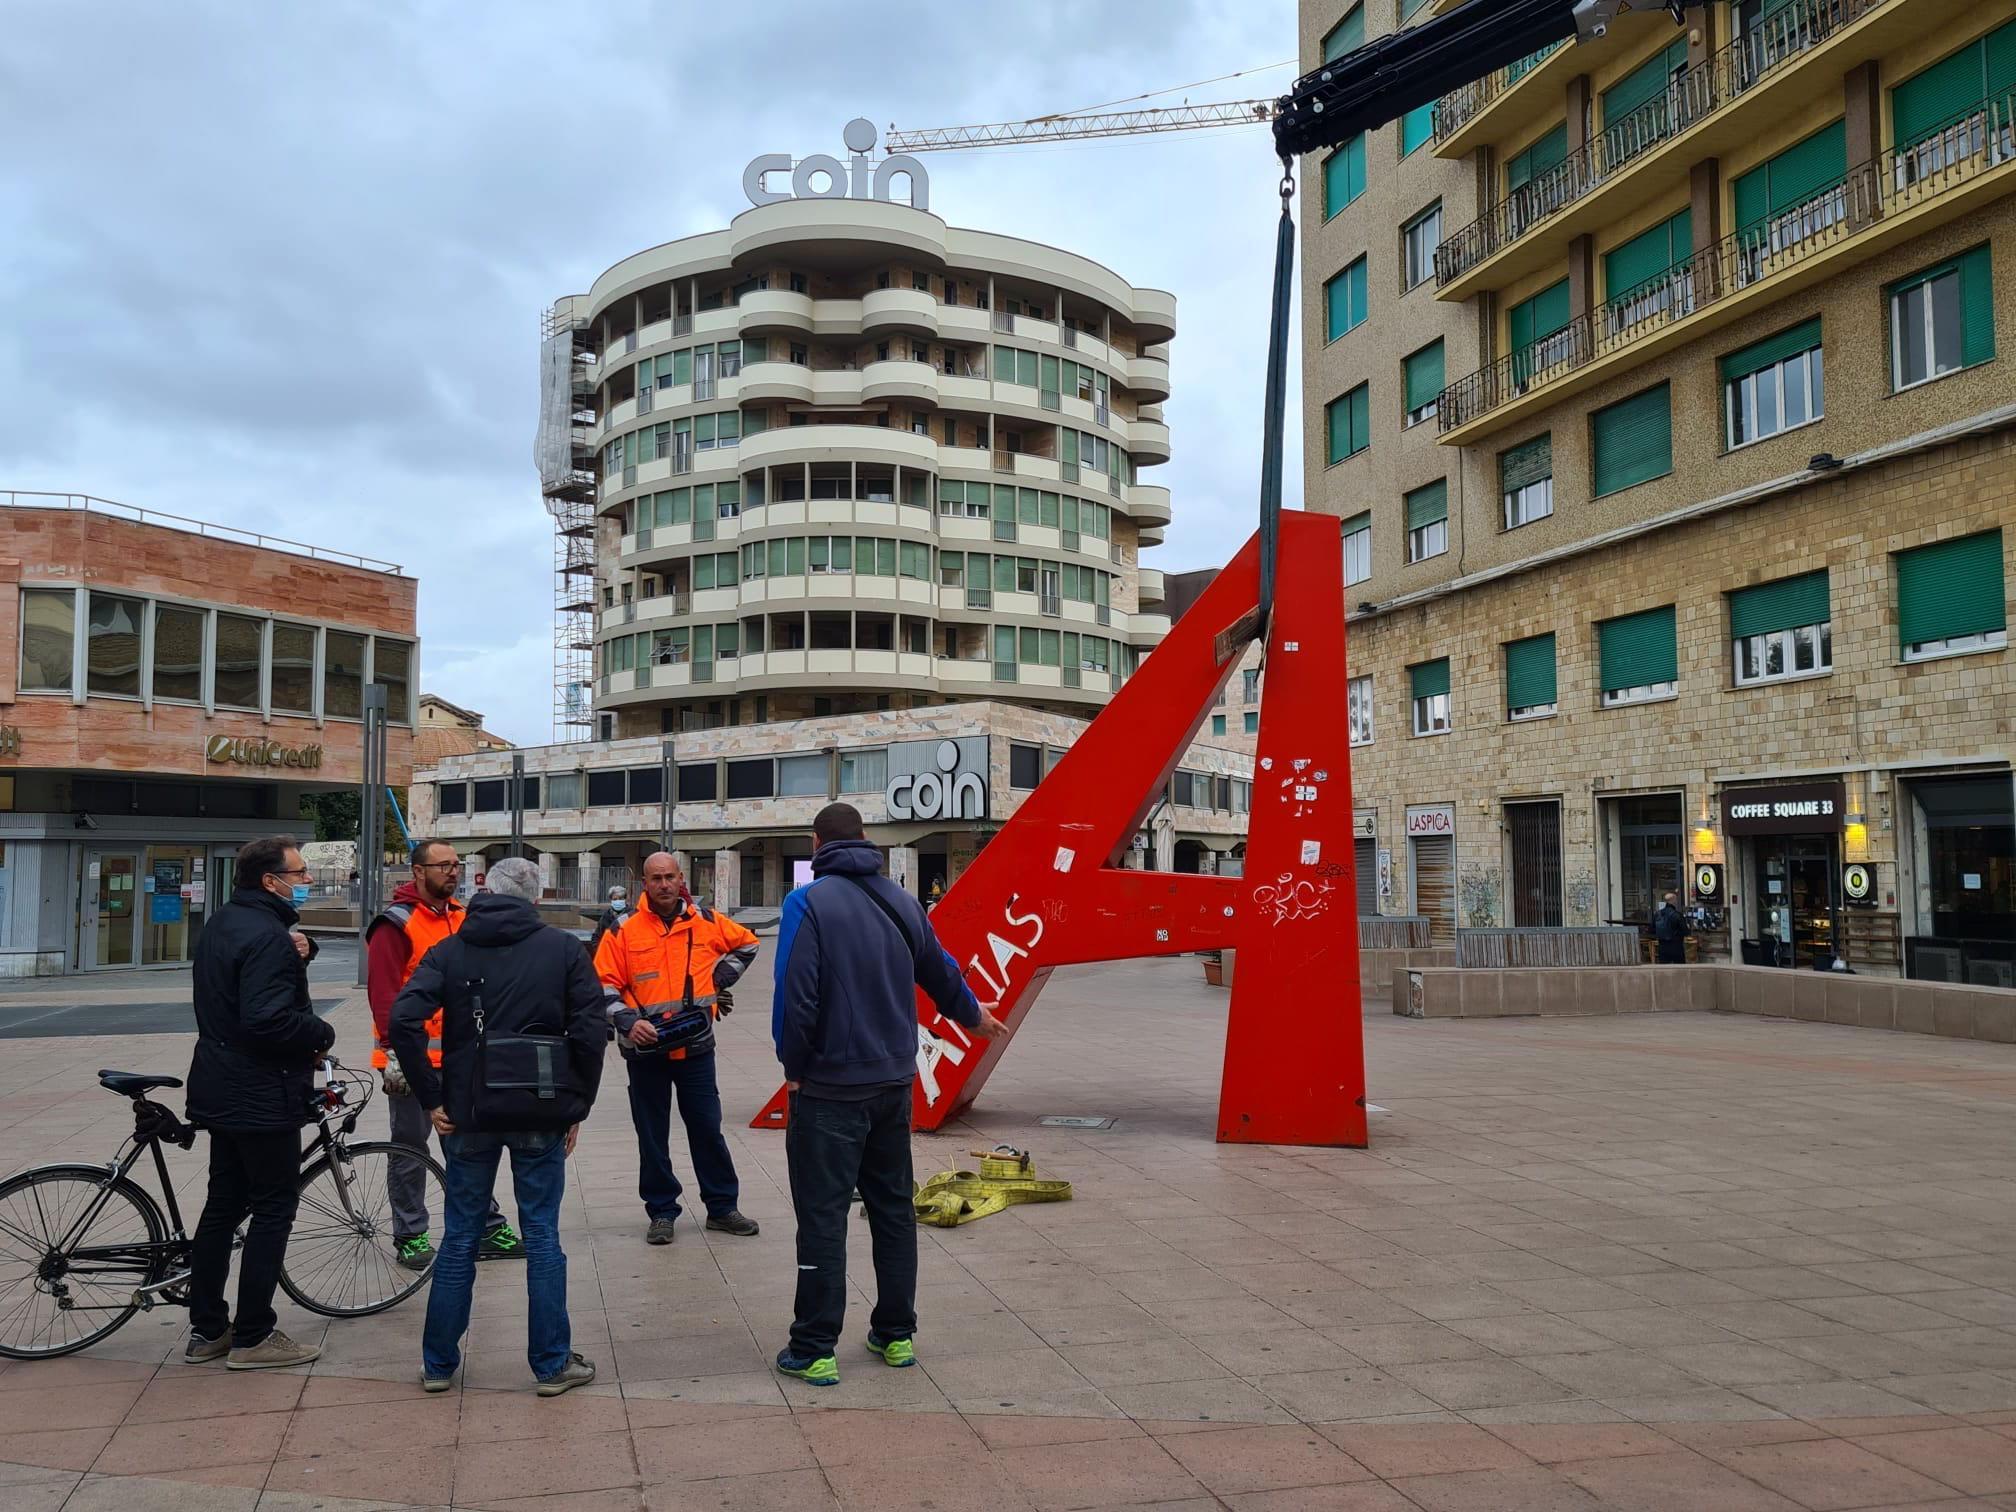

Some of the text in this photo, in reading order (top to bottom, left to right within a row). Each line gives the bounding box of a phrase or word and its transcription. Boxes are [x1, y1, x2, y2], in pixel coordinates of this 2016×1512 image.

[743, 118, 929, 211] coin
[234, 738, 324, 768] UniCredit
[886, 740, 987, 820] coin
[1409, 813, 1451, 831] LASPICA
[1731, 800, 1834, 818] COFFEE SQUARE 33
